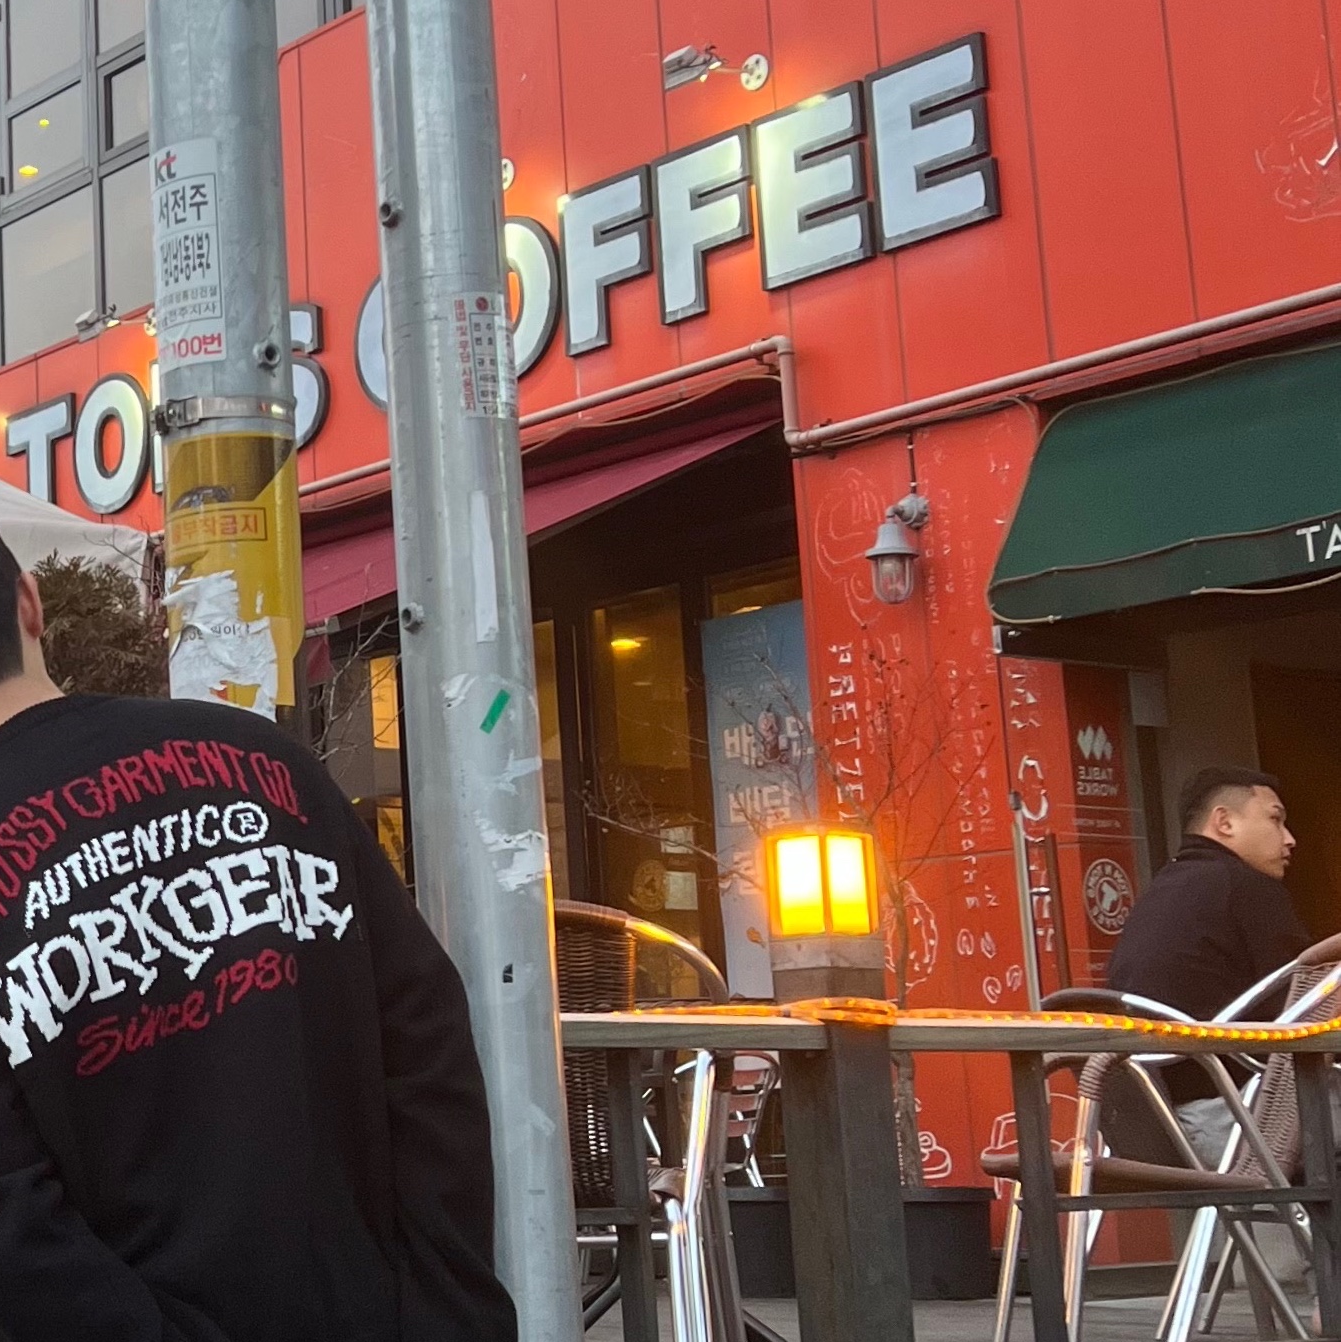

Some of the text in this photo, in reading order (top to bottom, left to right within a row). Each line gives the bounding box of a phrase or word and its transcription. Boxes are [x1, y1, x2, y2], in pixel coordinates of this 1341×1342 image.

[154, 150, 177, 187] kt
[159, 183, 209, 229] 서전주
[62, 739, 248, 819] GARMENT
[76, 948, 299, 1077] Since 1980
